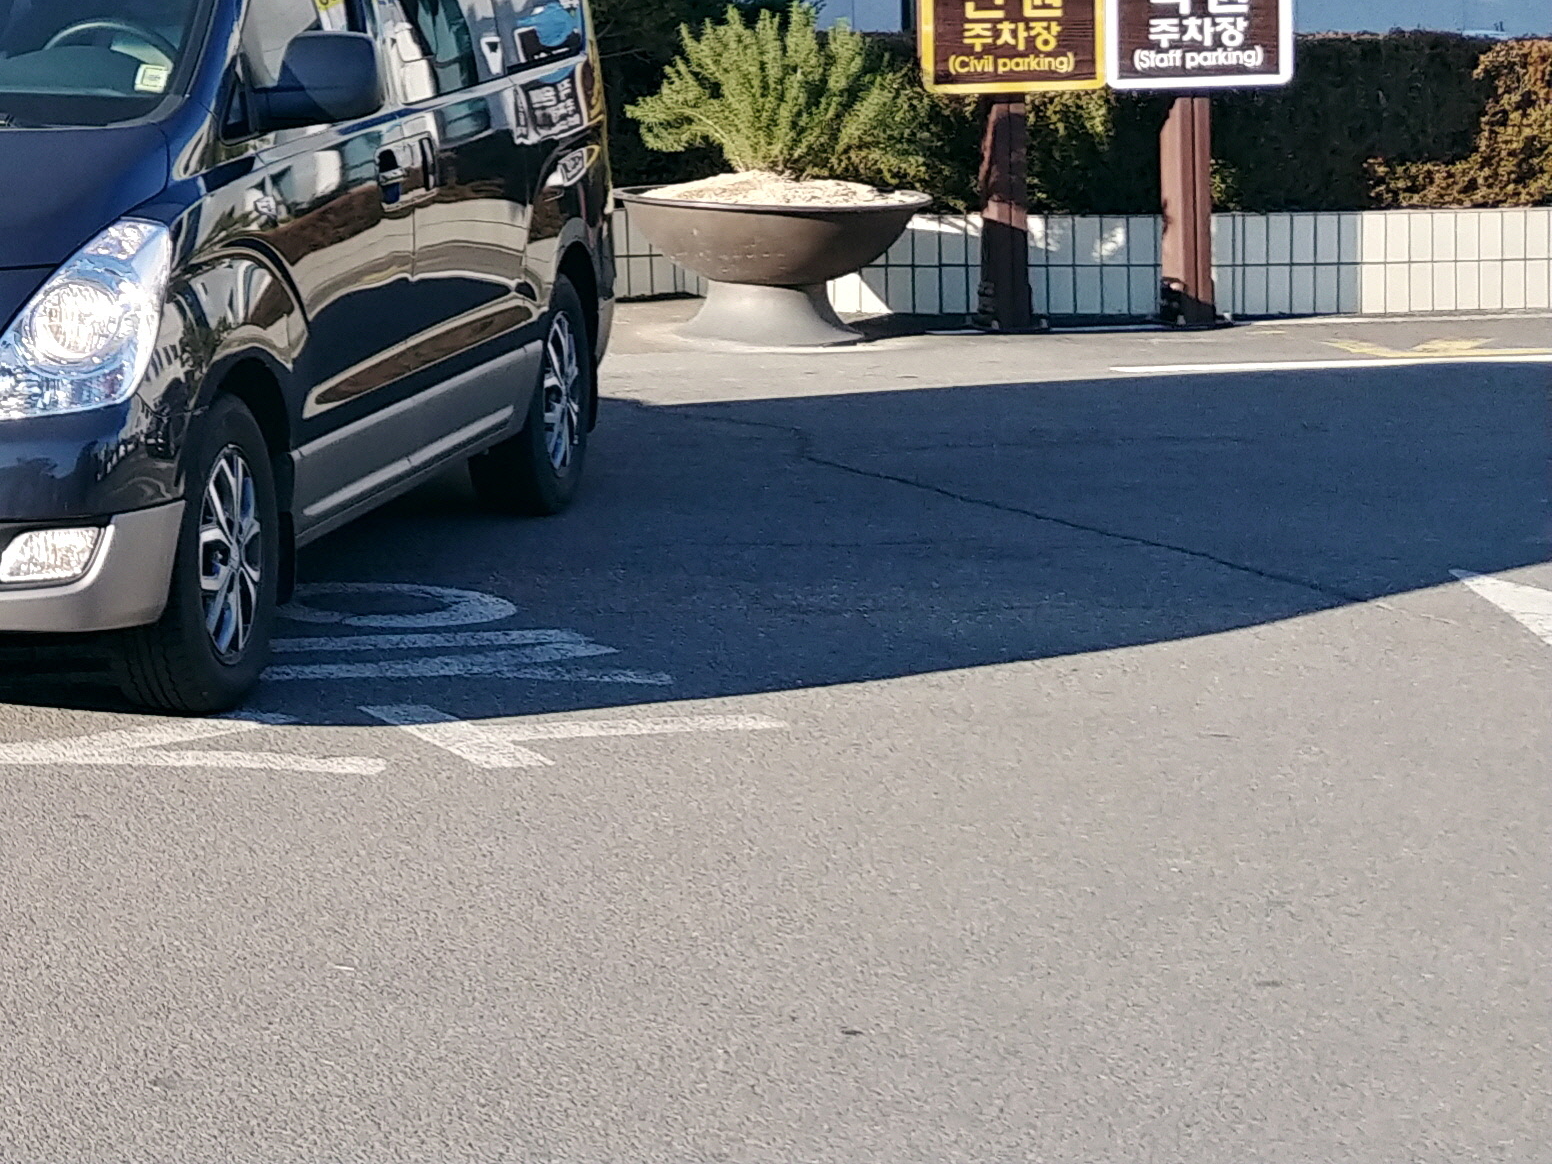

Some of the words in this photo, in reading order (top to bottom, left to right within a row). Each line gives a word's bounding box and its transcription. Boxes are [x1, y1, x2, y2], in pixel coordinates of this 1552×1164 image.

[962, 20, 1062, 53] 주차장
[1148, 17, 1249, 48] 주차장
[949, 53, 995, 76] (Civil
[997, 53, 1075, 75] parking)
[1133, 47, 1183, 71] (Staff
[1184, 44, 1264, 68] parking)
